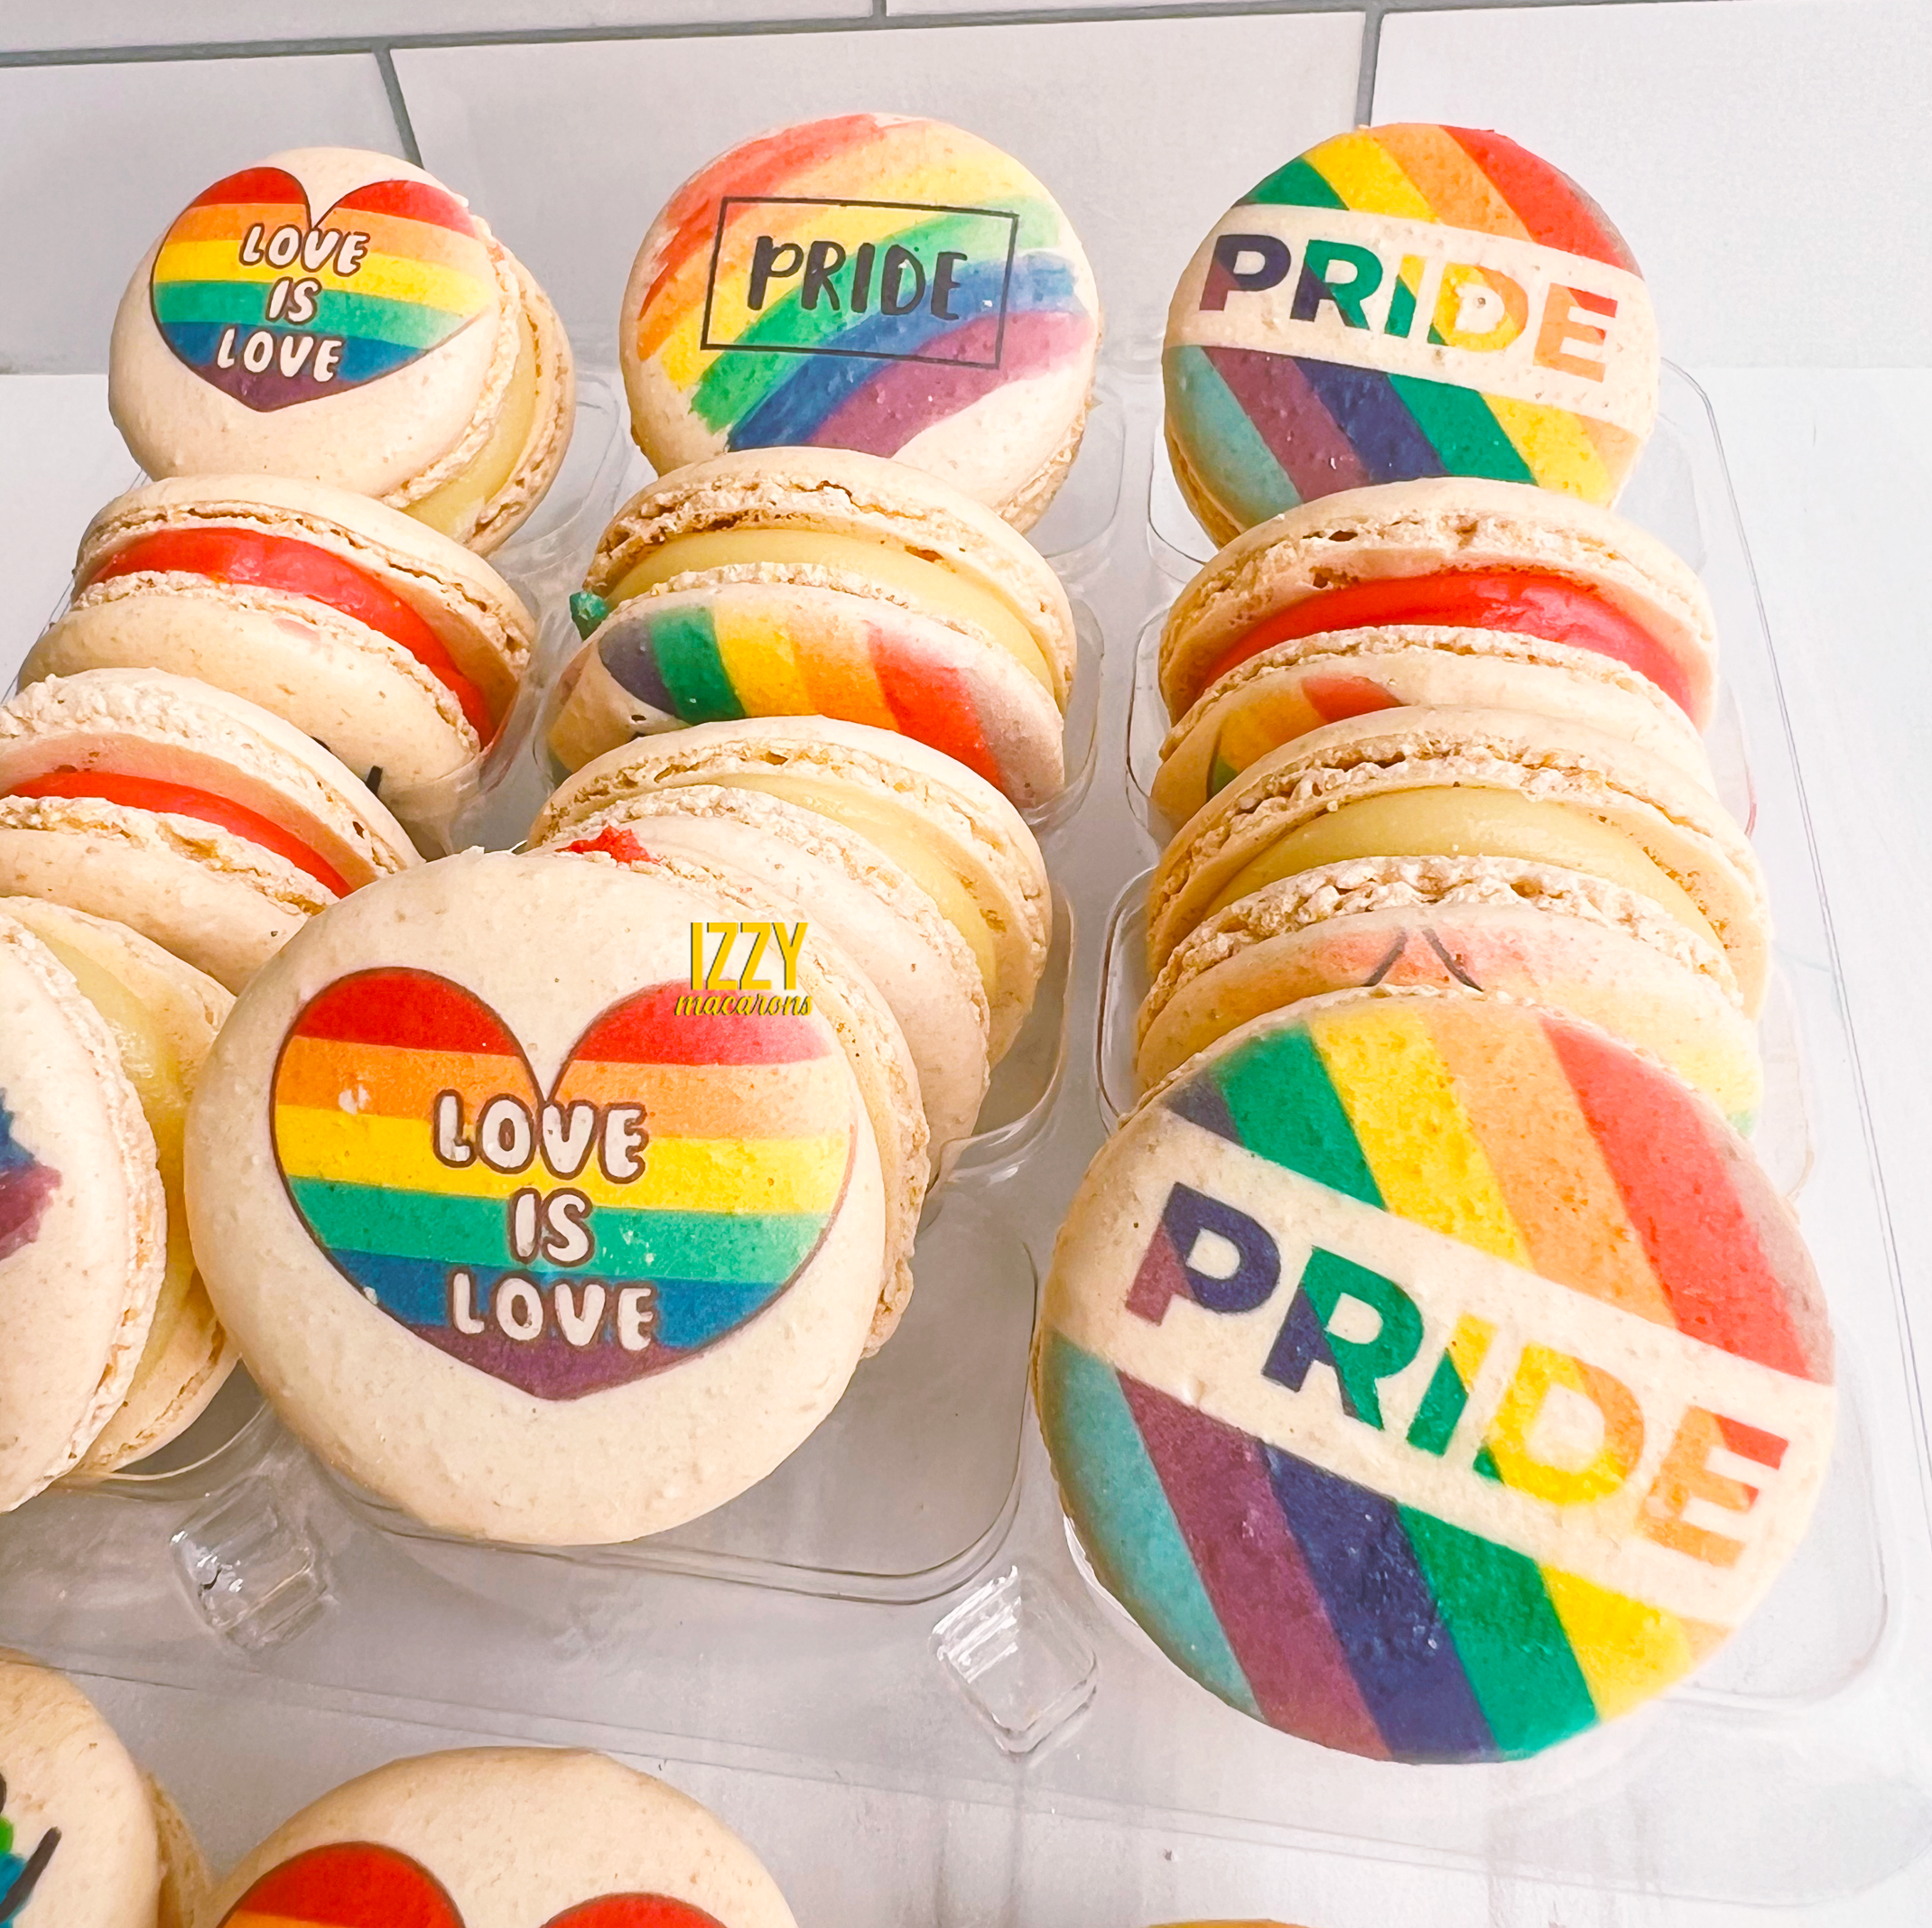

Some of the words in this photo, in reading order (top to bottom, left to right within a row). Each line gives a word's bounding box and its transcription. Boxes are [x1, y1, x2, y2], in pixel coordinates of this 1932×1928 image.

[239, 223, 370, 276] LOVE
[747, 236, 968, 320] PRIDE
[266, 277, 321, 324] IS
[1199, 234, 1618, 383] PRIDE
[217, 328, 343, 382] LOVE
[433, 1089, 646, 1183] LOVE
[507, 1188, 594, 1265] IS
[451, 1272, 659, 1351] LOVE
[1125, 1182, 1789, 1568] PRIDE
